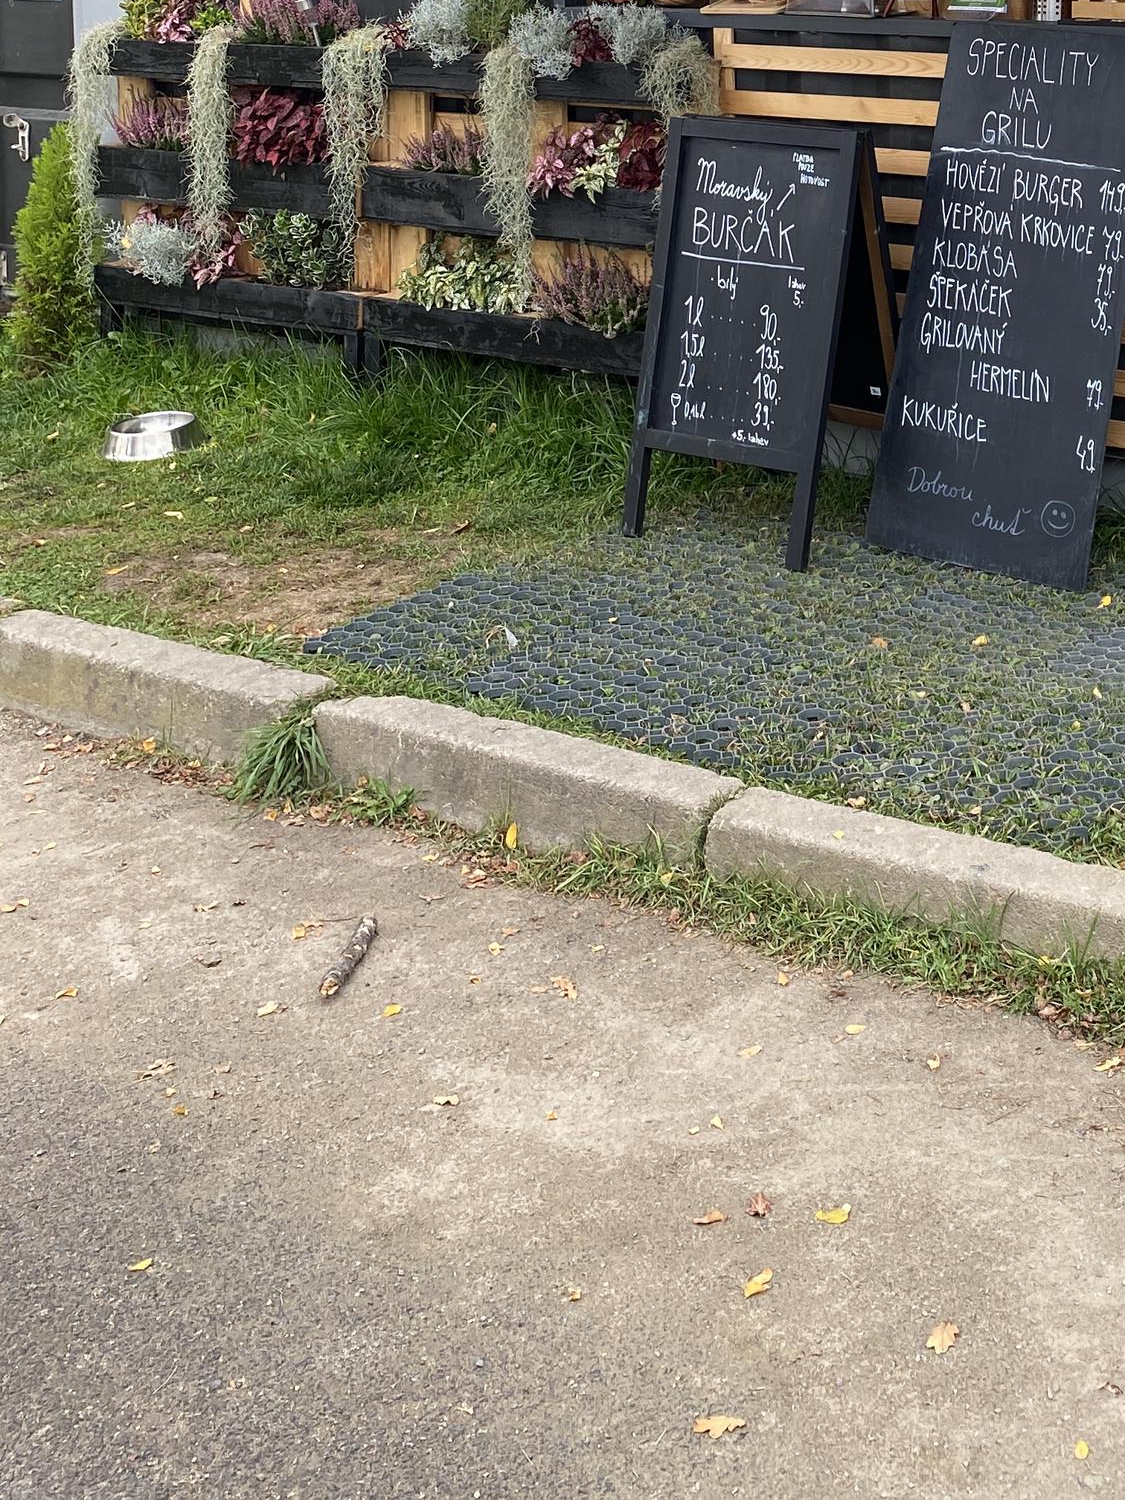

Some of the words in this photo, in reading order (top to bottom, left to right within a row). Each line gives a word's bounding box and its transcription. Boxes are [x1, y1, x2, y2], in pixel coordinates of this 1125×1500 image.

[966, 37, 1100, 87] SPECIALITY
[1009, 87, 1039, 115] NA
[981, 110, 1052, 150] GRILU
[792, 151, 814, 164] PLATBA
[798, 160, 815, 173] POUZE
[696, 158, 775, 224] Moravský
[1013, 168, 1083, 216] BURGER
[692, 206, 796, 264] BURČÁK
[941, 198, 1014, 240] VEPŘOVÁ
[1020, 212, 1095, 255] KRKOVICE
[932, 236, 1018, 279] KLOBÁSA
[927, 270, 1013, 318] ŠPEKÁČEK
[920, 312, 1008, 355] GRILOVANÝ
[756, 344, 784, 374] 135,-
[753, 371, 782, 405] 180,-
[970, 360, 1050, 403] HERMELÍN
[751, 401, 775, 431] 39,-
[901, 395, 988, 442] KUKUŘICE
[747, 432, 769, 447] lahev
[906, 466, 974, 501] Dobrou
